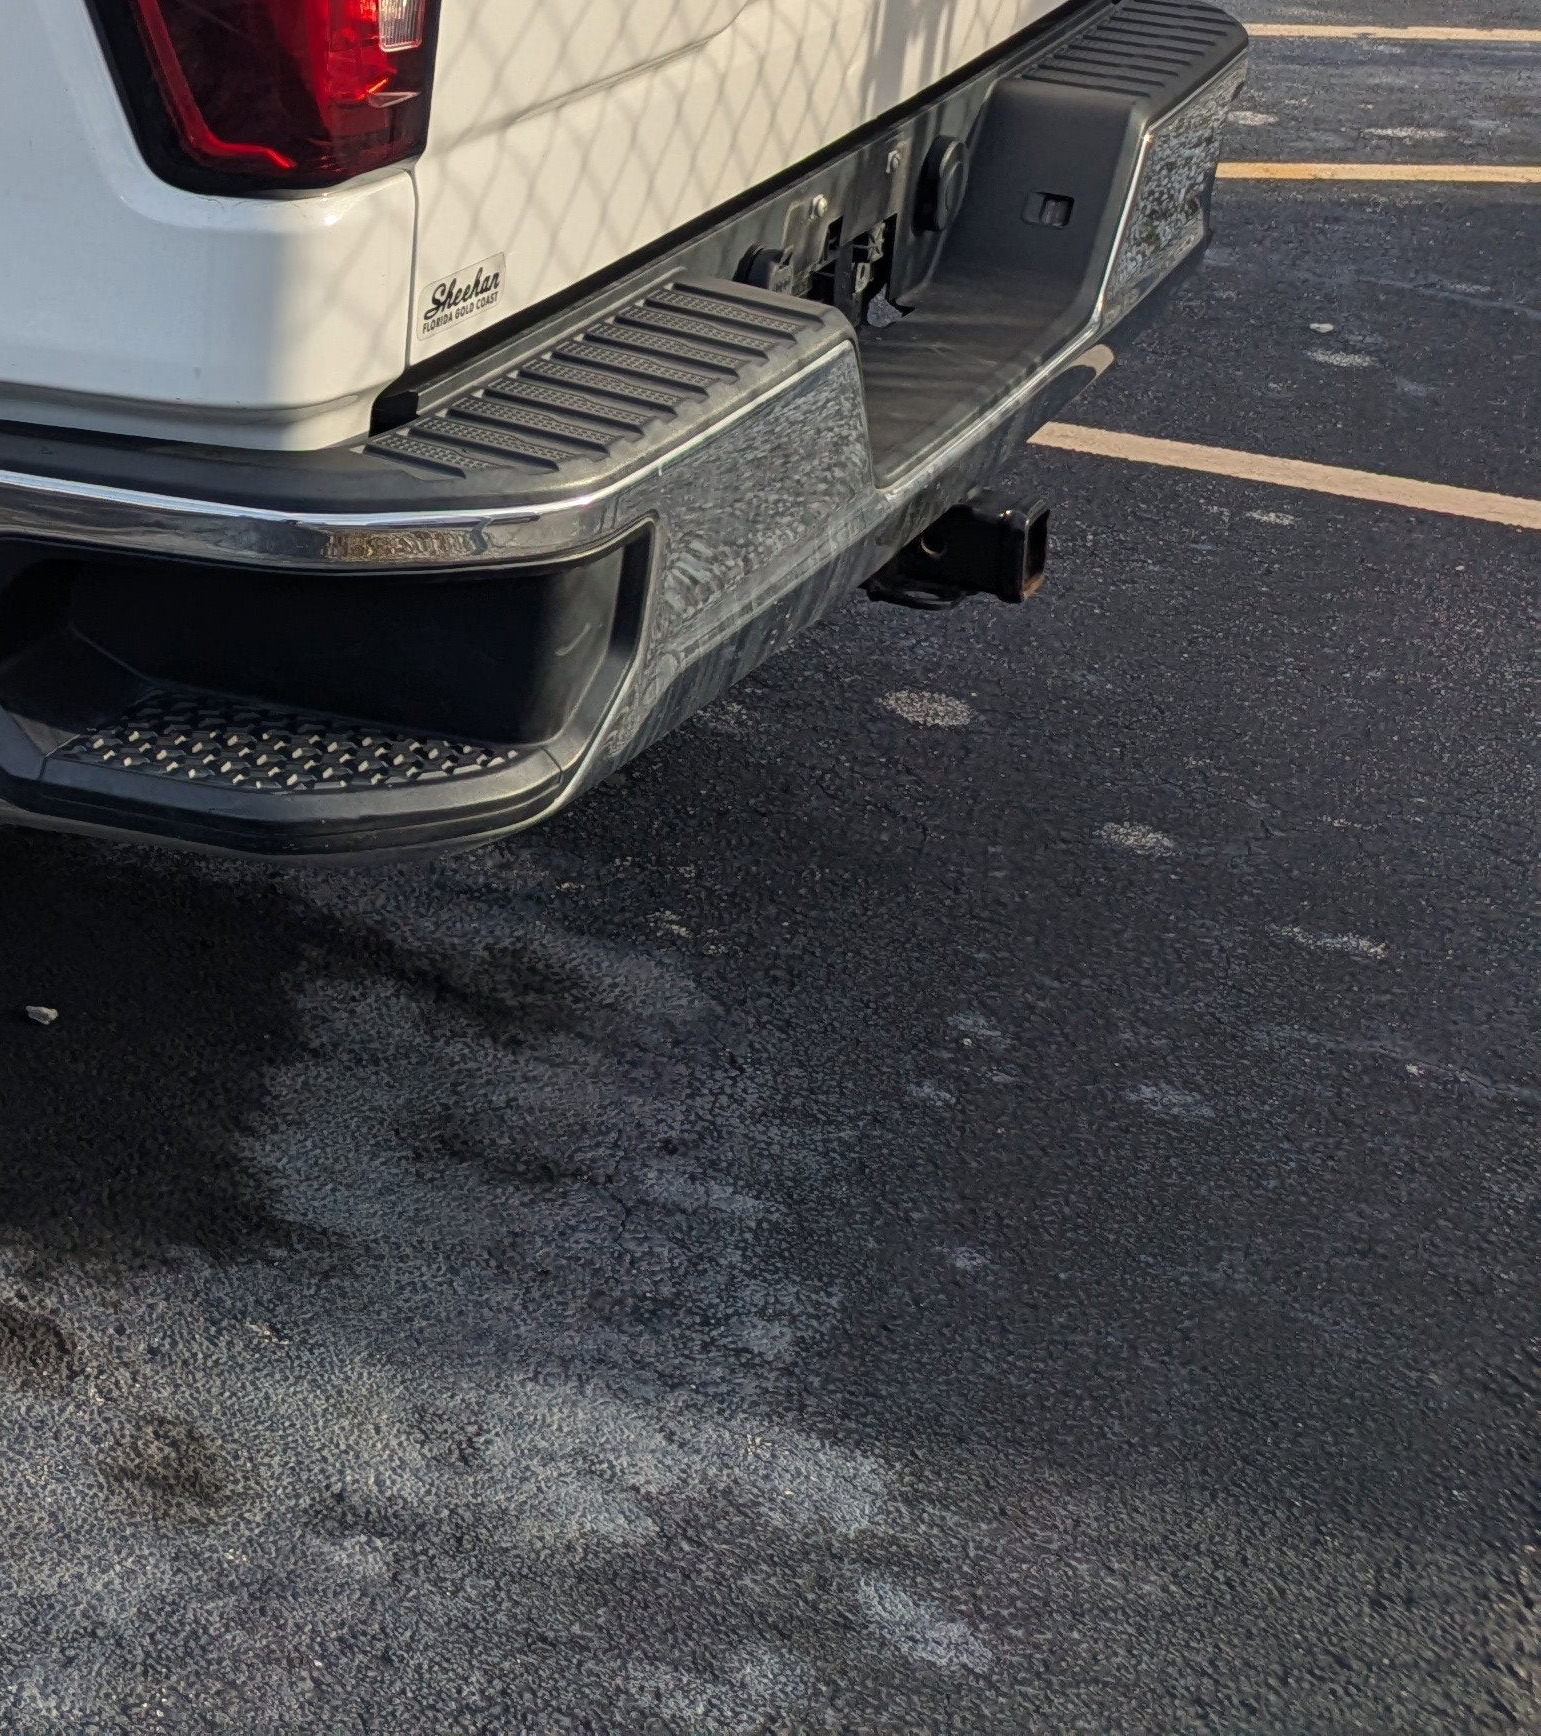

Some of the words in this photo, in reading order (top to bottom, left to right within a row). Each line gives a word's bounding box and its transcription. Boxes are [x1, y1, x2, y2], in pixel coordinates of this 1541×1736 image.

[422, 312, 454, 335] FLORIDA
[454, 301, 475, 321] GOLD
[476, 290, 500, 311] COAST
[423, 266, 500, 321] Sheehan
